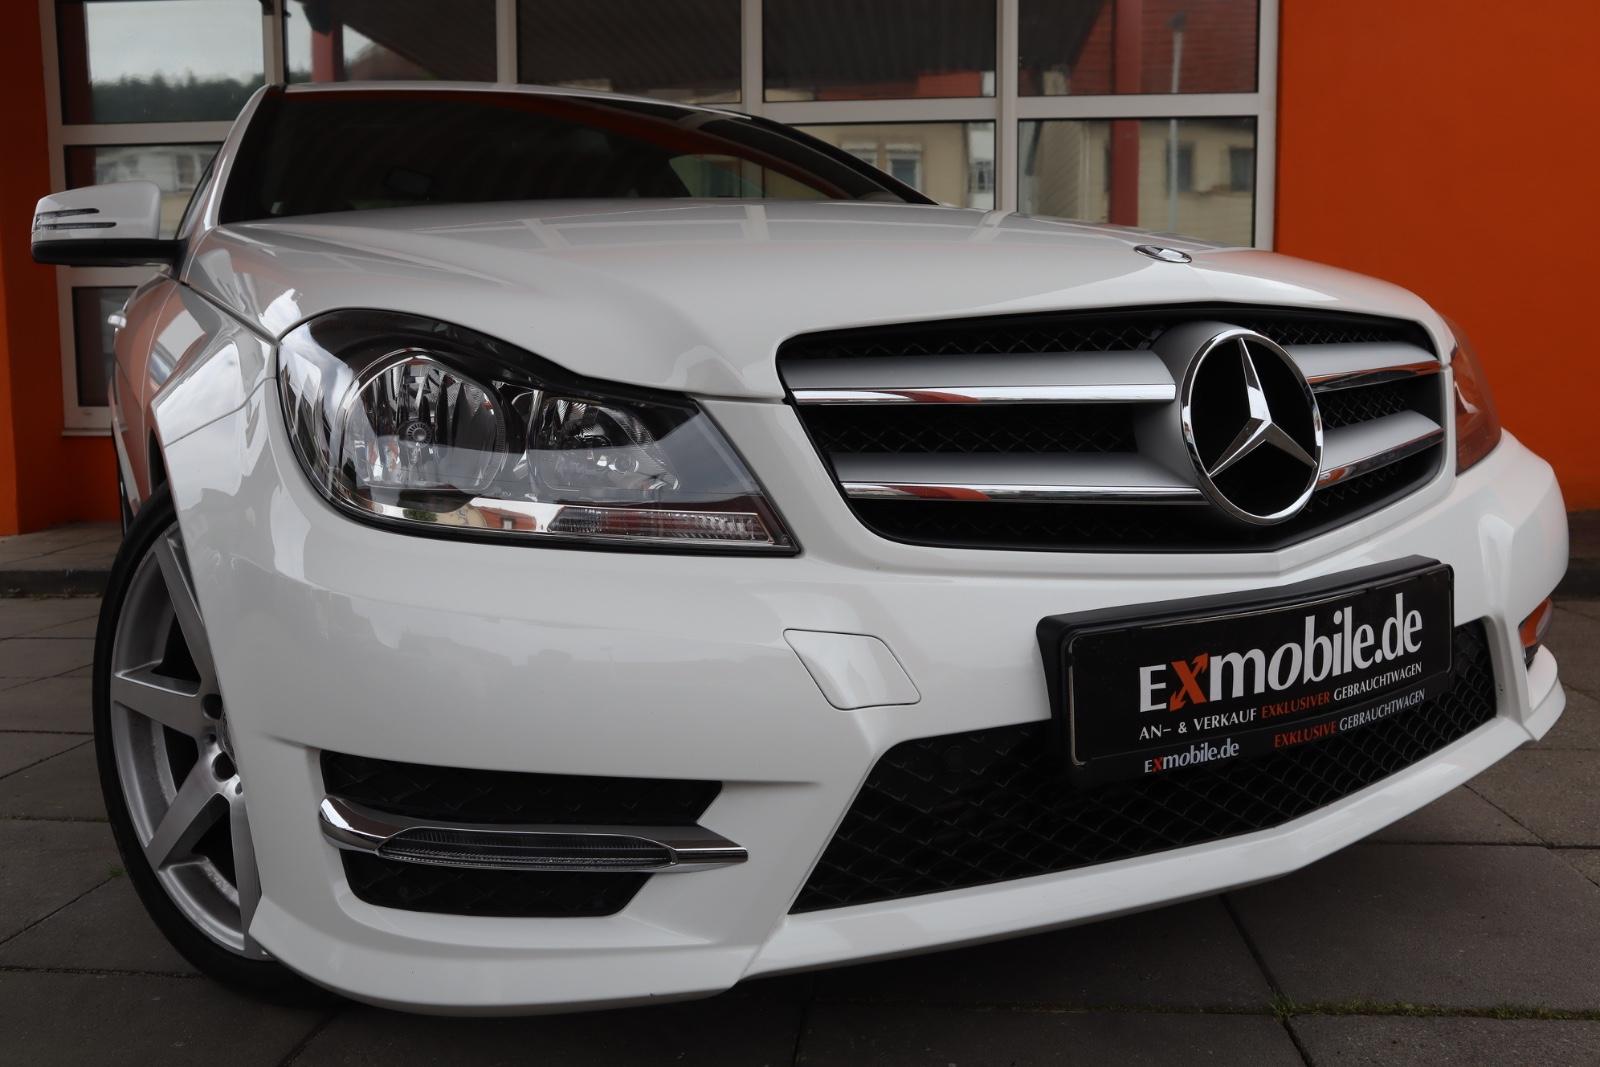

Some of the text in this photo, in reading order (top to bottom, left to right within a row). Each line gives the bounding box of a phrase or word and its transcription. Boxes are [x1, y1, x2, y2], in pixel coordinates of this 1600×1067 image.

[1178, 721, 1188, 734] &
[1193, 708, 1257, 731] VERKAUF
[1261, 691, 1330, 719] EXKLUSIVER
[1333, 662, 1422, 701] GEBRAUCHTWAGEN
[1274, 688, 1425, 748] EXKLUSIVE GEBRAUCHTWAGEN
